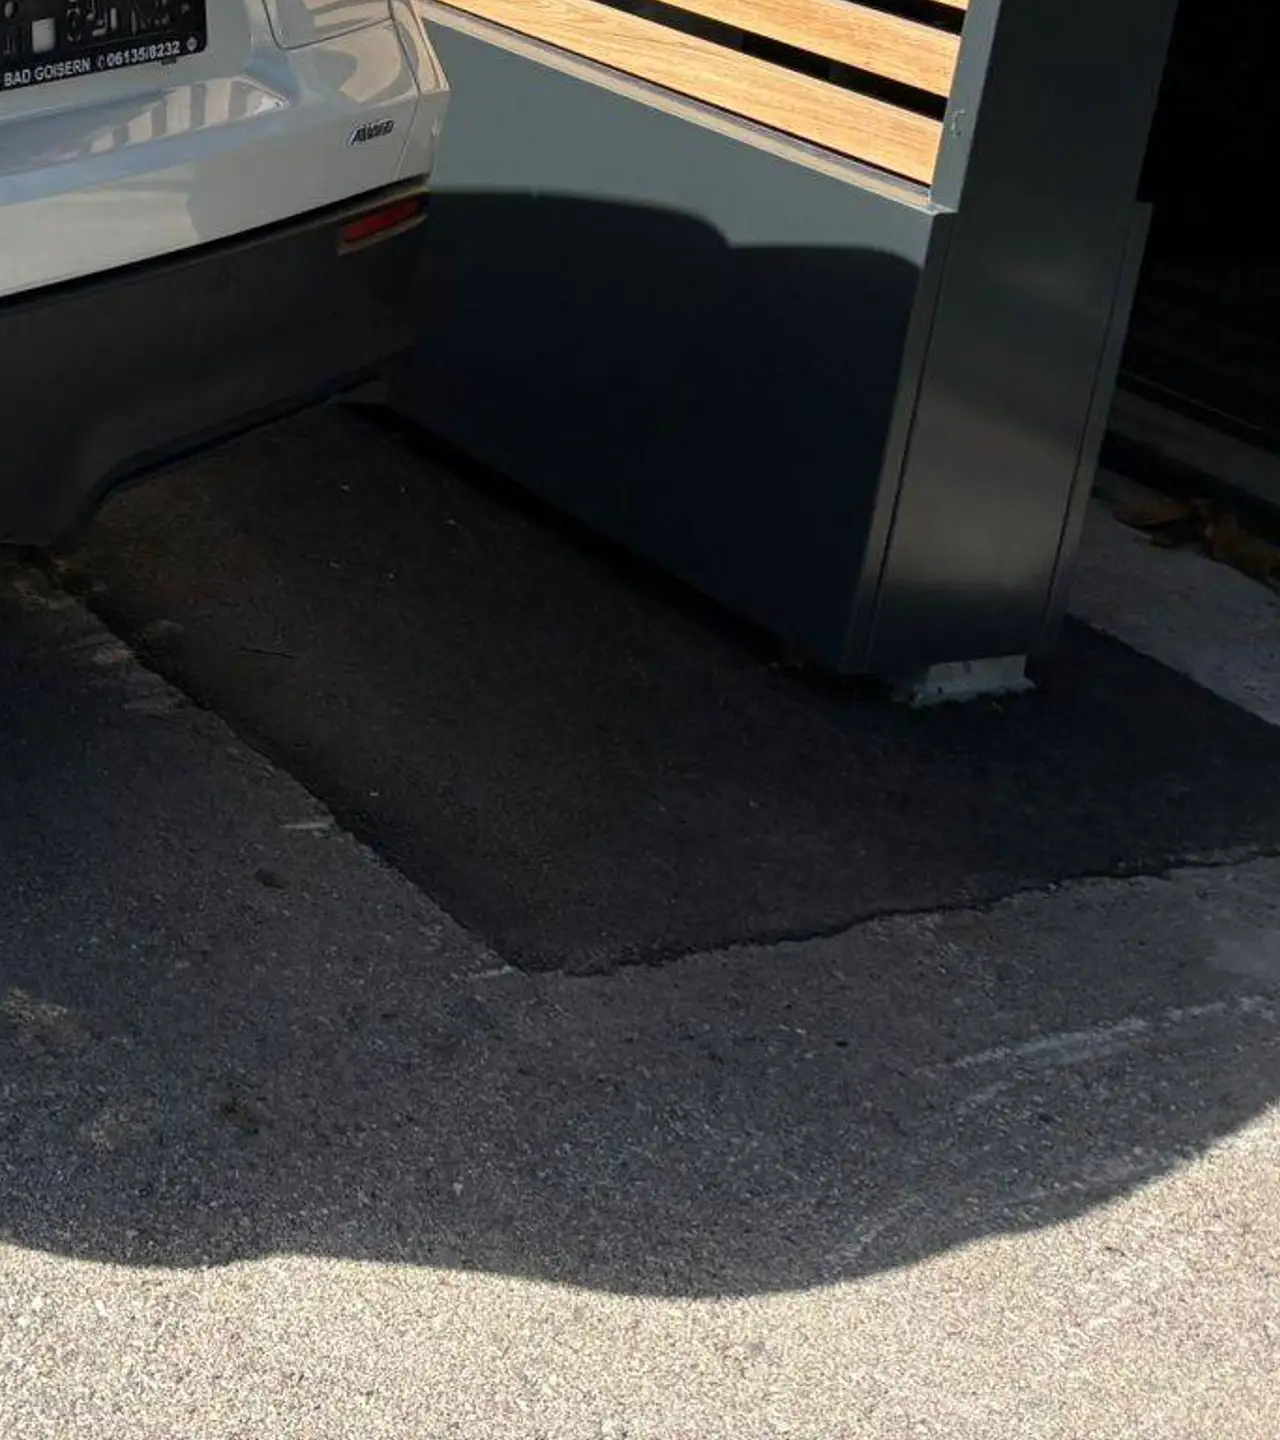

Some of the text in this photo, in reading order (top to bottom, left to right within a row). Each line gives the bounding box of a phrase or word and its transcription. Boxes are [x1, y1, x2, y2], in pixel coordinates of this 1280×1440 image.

[3, 71, 32, 88] BAD
[34, 58, 91, 80] GOISERN
[106, 40, 181, 67] 06135/8232
